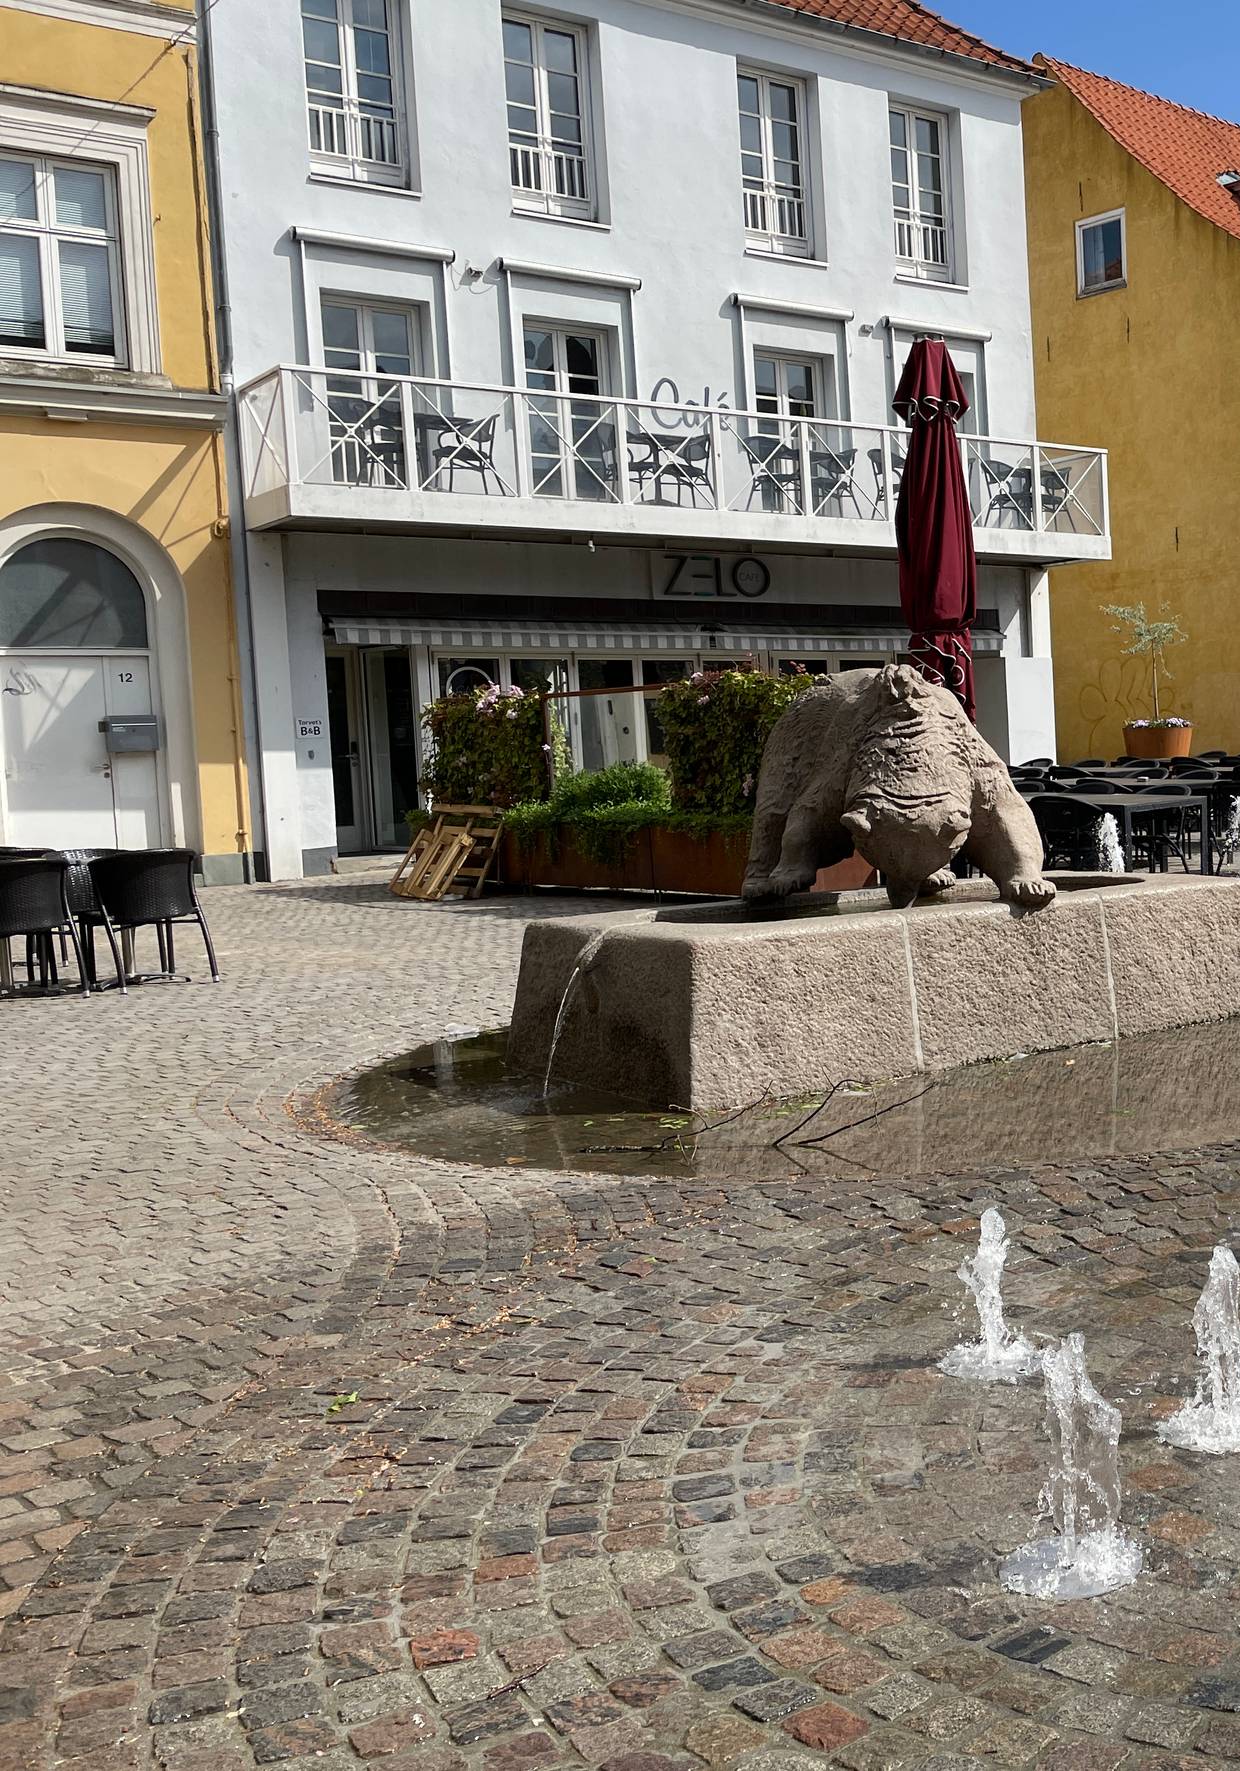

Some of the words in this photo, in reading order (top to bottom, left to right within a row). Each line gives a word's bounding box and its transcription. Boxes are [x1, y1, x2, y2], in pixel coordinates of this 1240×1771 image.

[651, 378, 730, 436] Café
[664, 555, 771, 598] ZELO
[118, 673, 133, 683] 12
[300, 726, 321, 736] B&B
